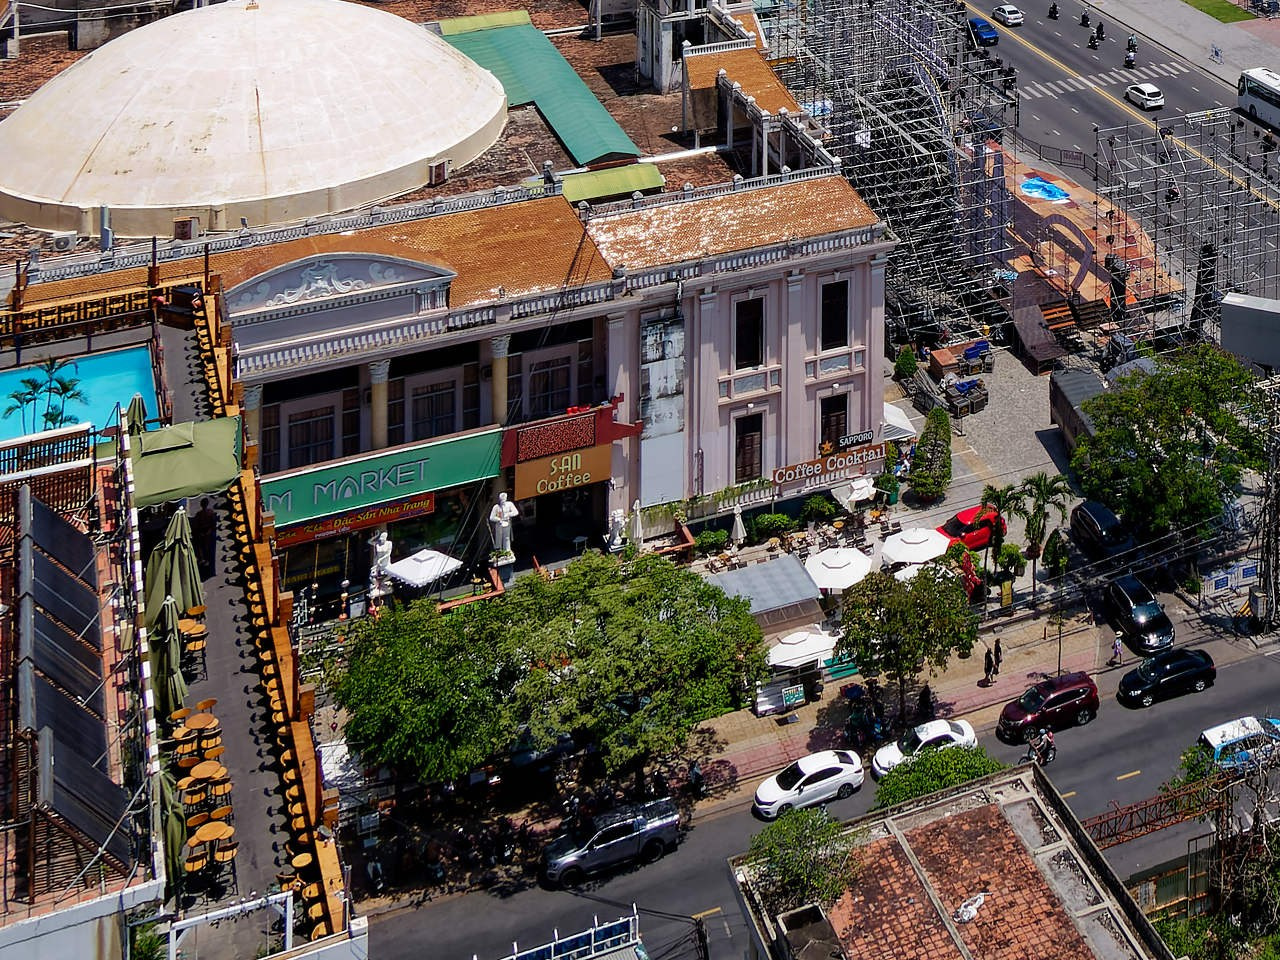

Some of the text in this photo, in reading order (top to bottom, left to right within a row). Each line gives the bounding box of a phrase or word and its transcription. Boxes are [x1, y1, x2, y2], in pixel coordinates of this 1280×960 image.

[839, 431, 873, 447] SAPPORO
[550, 453, 582, 476] SAN
[775, 444, 887, 484] Coffee Cocktail
[268, 458, 430, 512] M MARKET
[537, 472, 591, 494] Coffee
[379, 505, 401, 517] Nha
[403, 499, 431, 512] Trang
